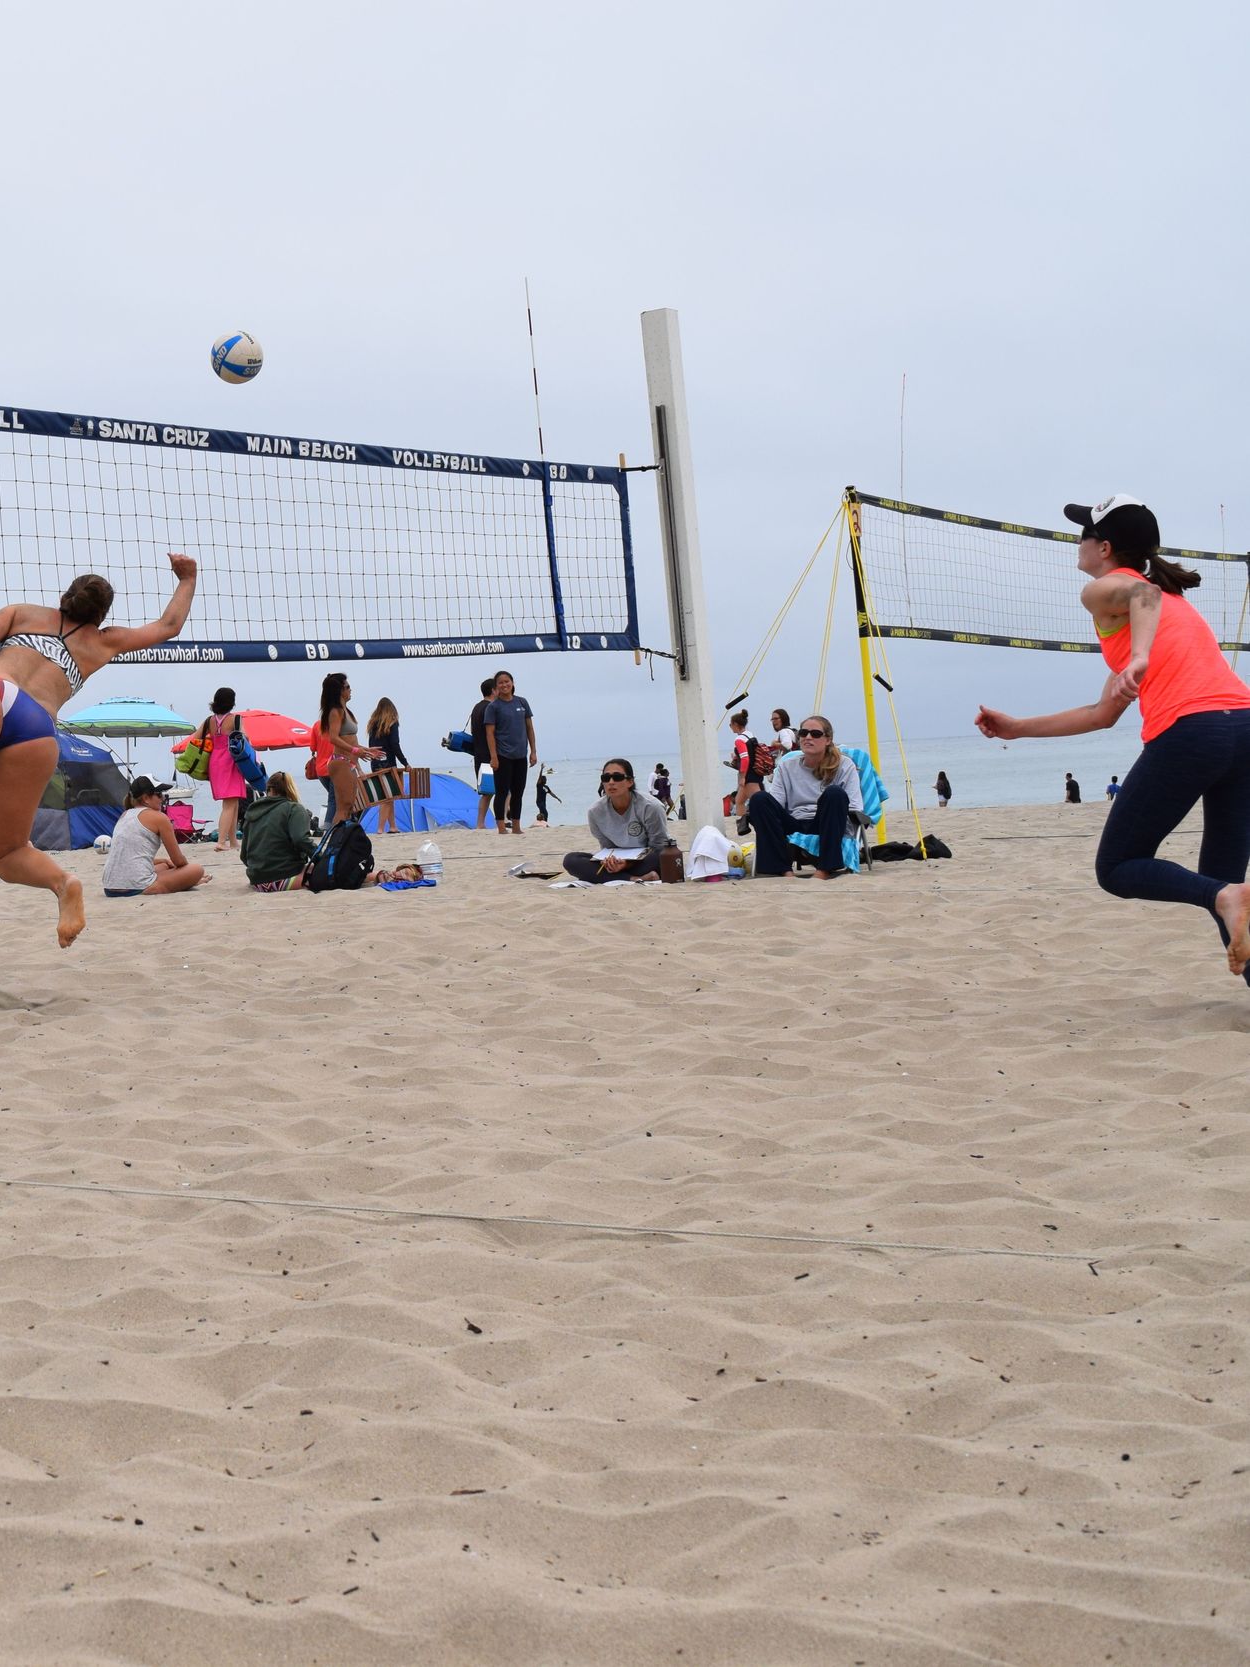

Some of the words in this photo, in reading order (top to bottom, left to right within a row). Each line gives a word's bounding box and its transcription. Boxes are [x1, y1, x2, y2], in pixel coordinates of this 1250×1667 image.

[98, 420, 157, 443] SANTA
[162, 427, 209, 448] CRUZ
[246, 436, 292, 455] MAIN
[299, 441, 357, 461] BEACH
[393, 450, 486, 473] VOLLEYBALL
[402, 640, 504, 657] www.santacruzwharf.com
